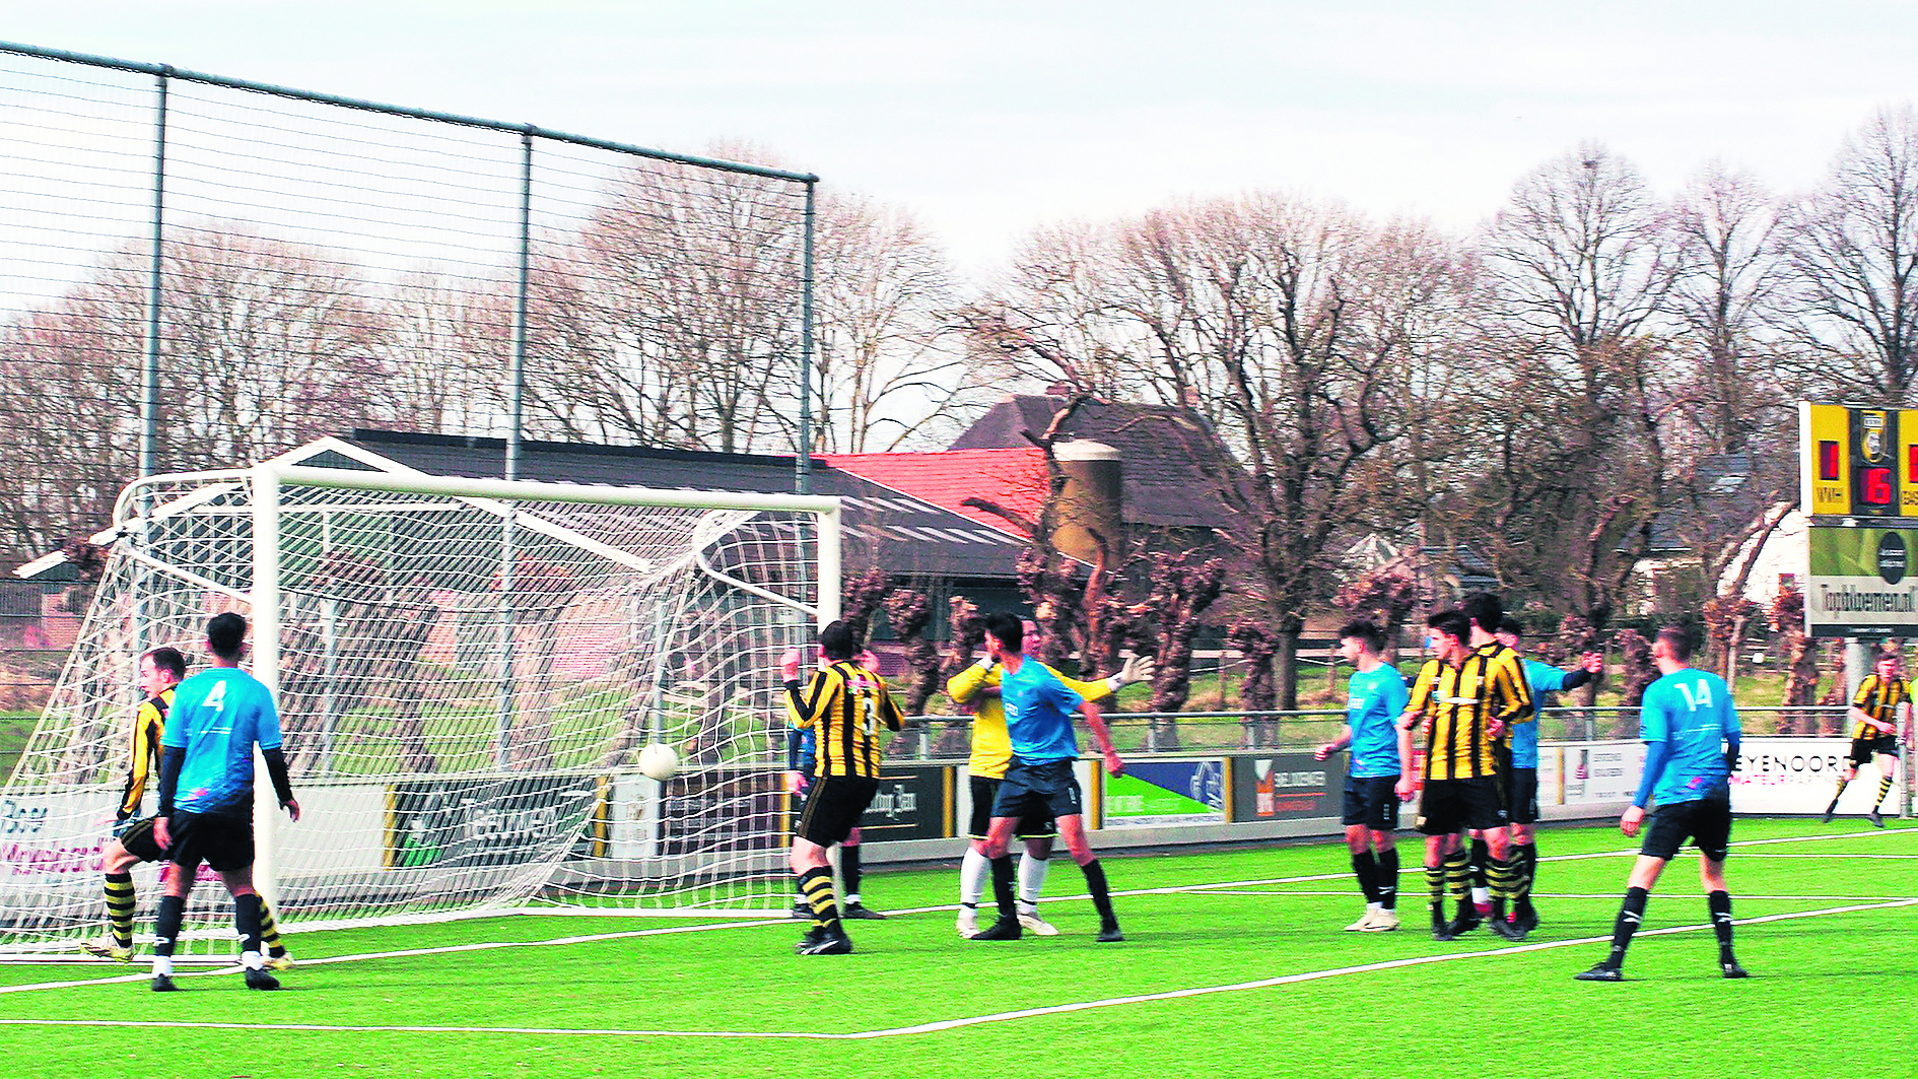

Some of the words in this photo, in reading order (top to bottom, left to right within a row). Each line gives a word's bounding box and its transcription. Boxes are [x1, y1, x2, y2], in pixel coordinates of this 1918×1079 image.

[1866, 467, 1891, 505] 6
[201, 680, 227, 712] 4
[1673, 678, 1713, 712] 14
